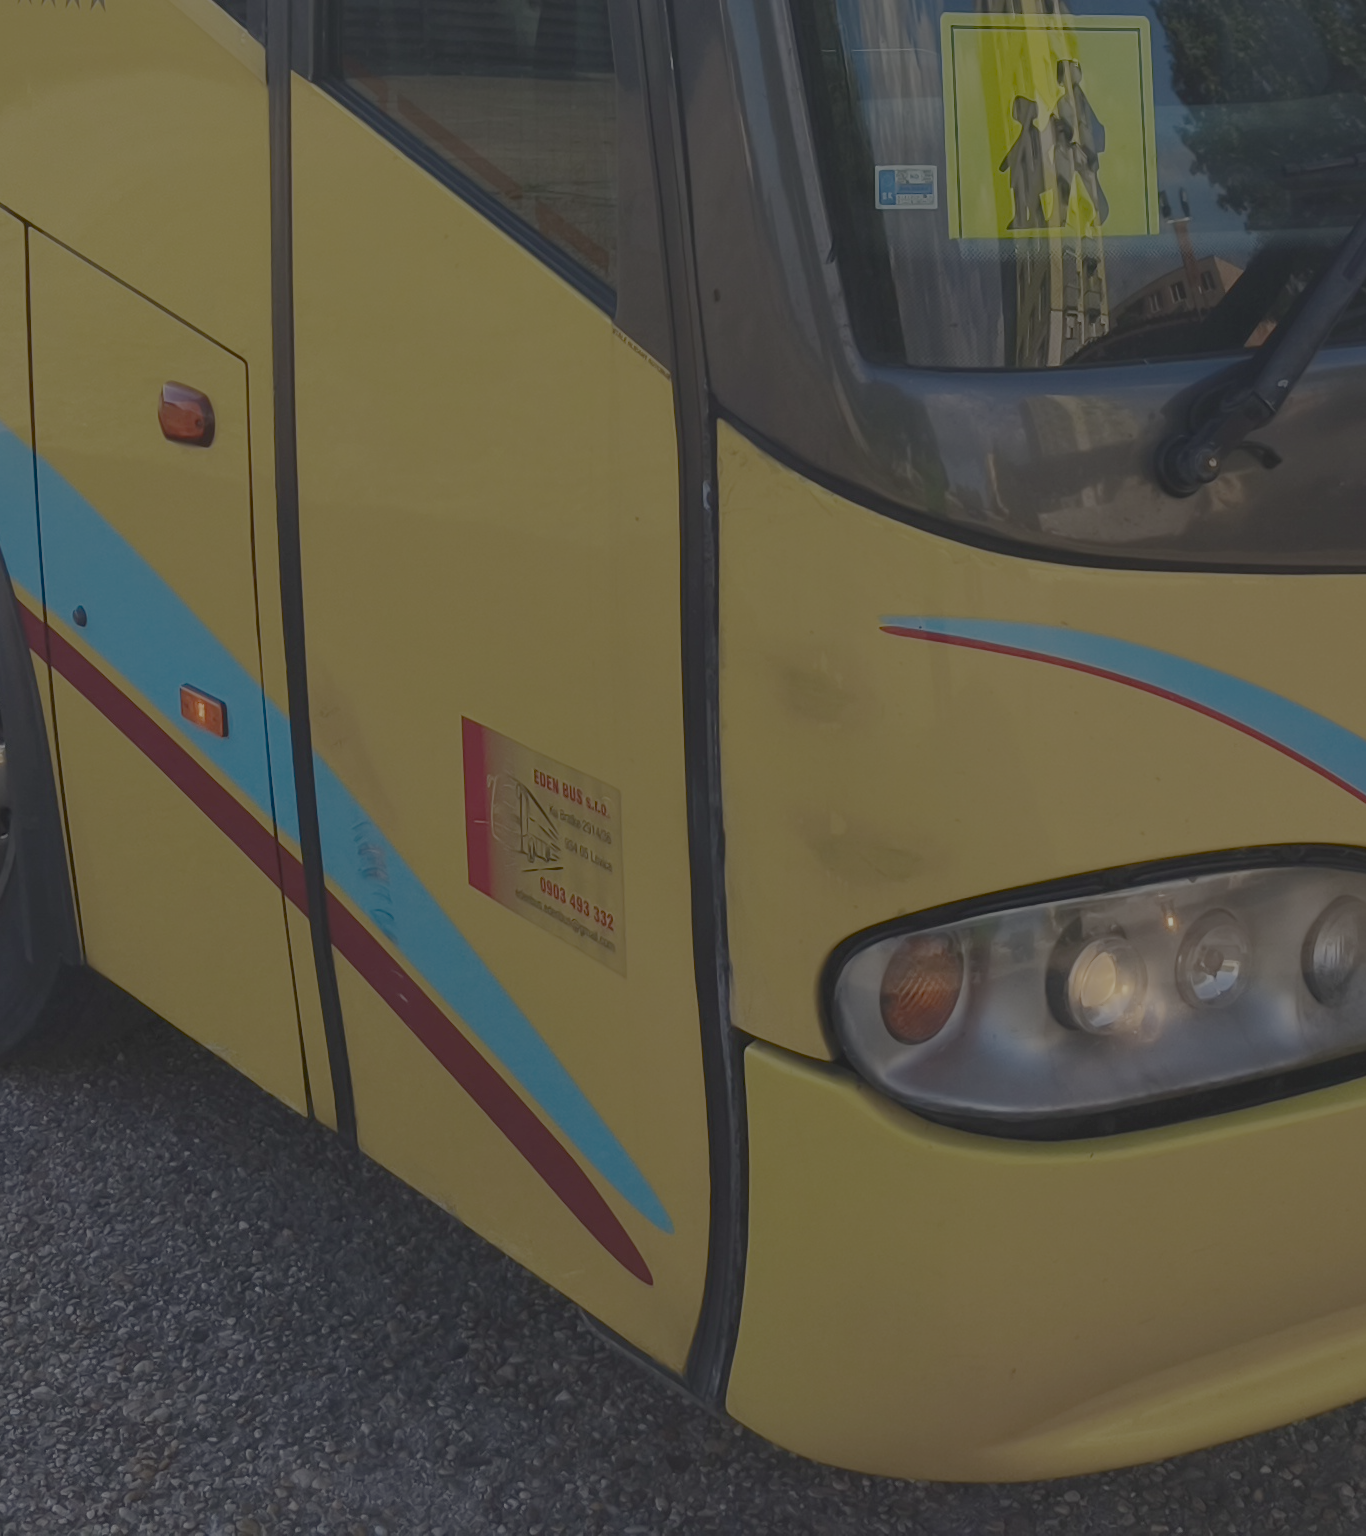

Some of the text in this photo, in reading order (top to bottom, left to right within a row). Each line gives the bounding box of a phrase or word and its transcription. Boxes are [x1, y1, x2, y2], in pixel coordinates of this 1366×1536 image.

[533, 768, 559, 794] EDEN
[562, 781, 584, 805] BUS
[539, 876, 614, 932] 0903 493 332
